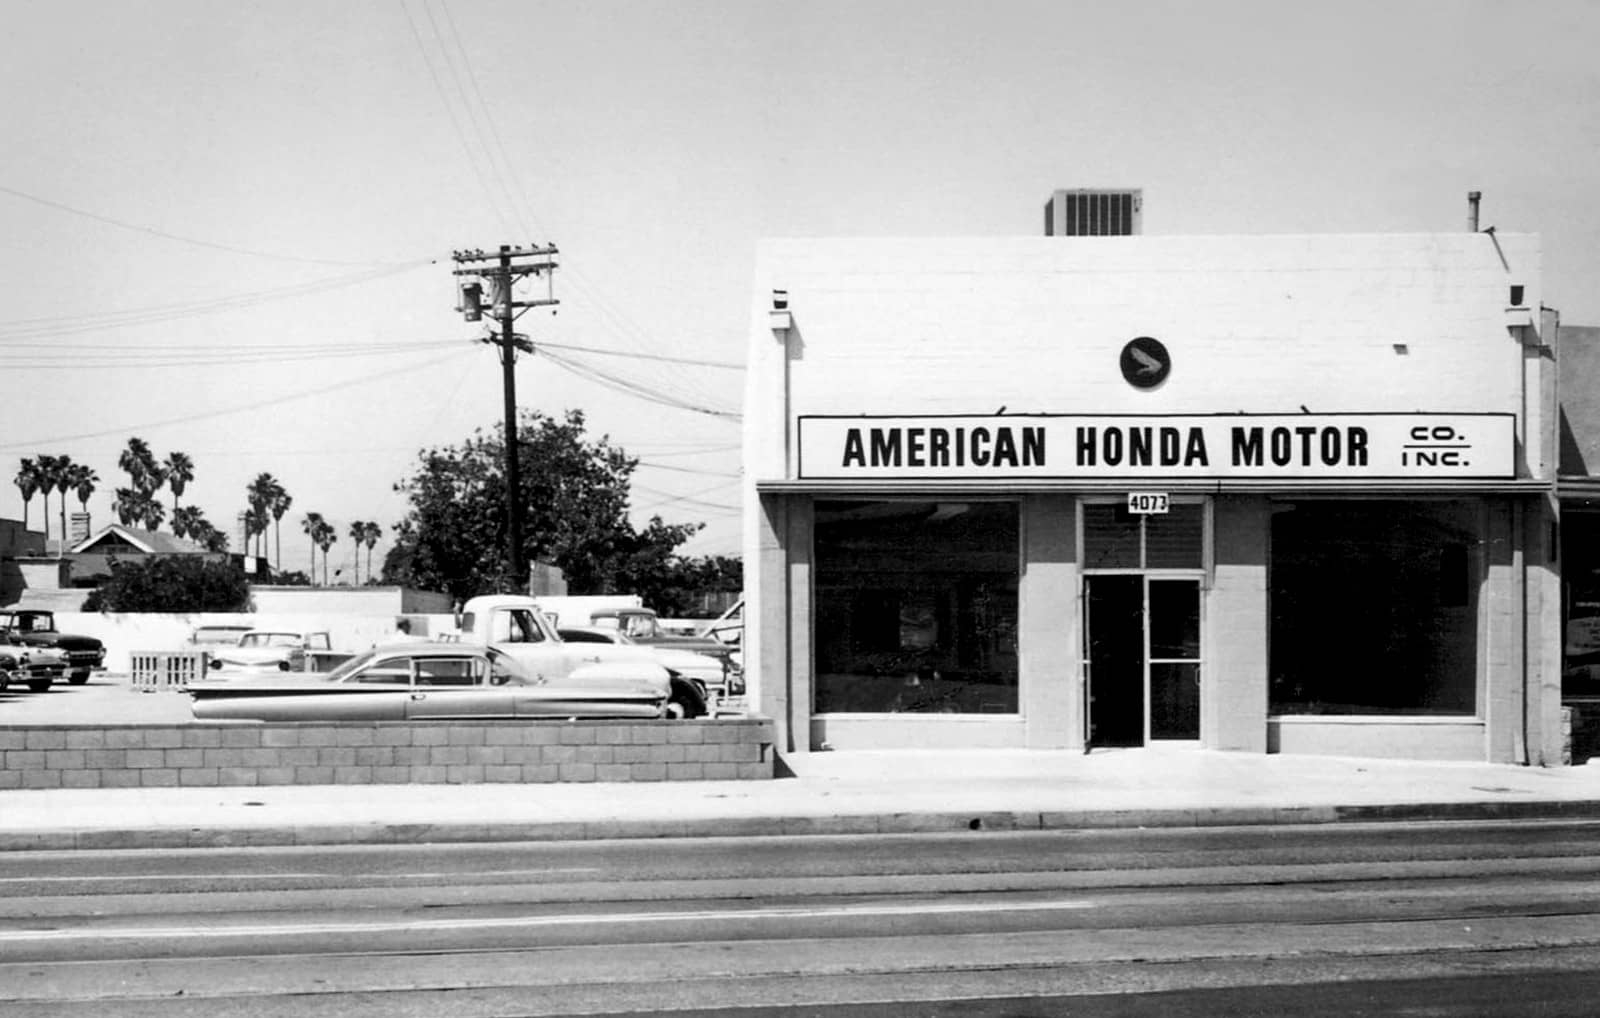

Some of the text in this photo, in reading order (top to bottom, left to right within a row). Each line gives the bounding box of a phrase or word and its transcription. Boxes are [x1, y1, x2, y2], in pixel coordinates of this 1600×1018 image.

[1410, 426, 1465, 441] CO.
[843, 426, 1368, 467] AMERICAN HONDA MOTOR
[1402, 452, 1470, 466] INC.
